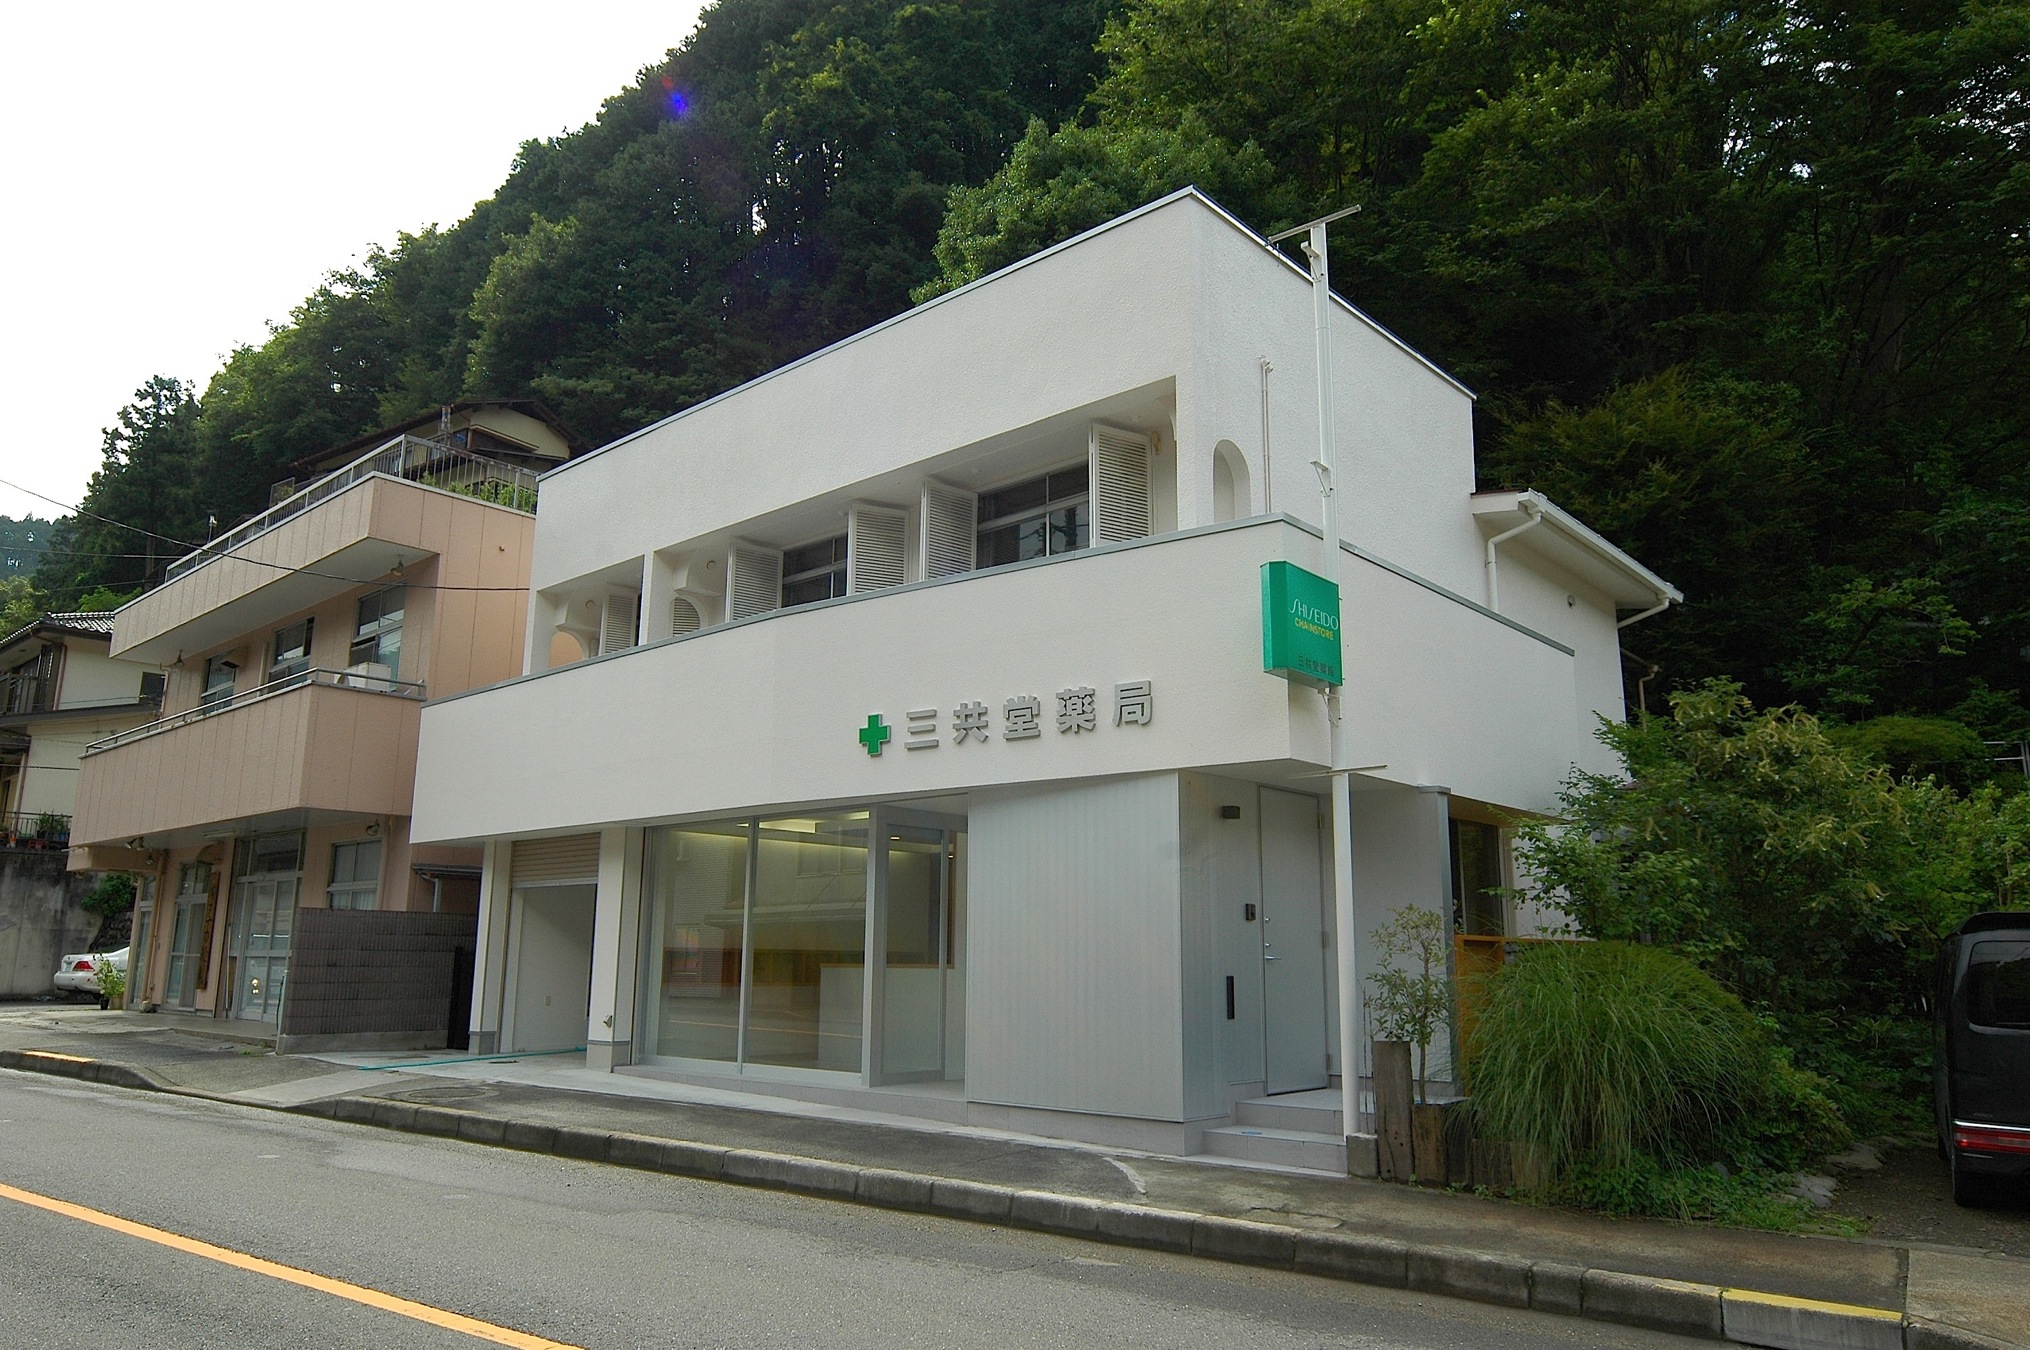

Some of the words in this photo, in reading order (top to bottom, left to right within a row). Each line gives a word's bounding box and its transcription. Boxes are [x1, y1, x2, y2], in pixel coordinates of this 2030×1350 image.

[1290, 599, 1338, 630] SHISEIDO
[904, 680, 1153, 750] 三共堂薬局
